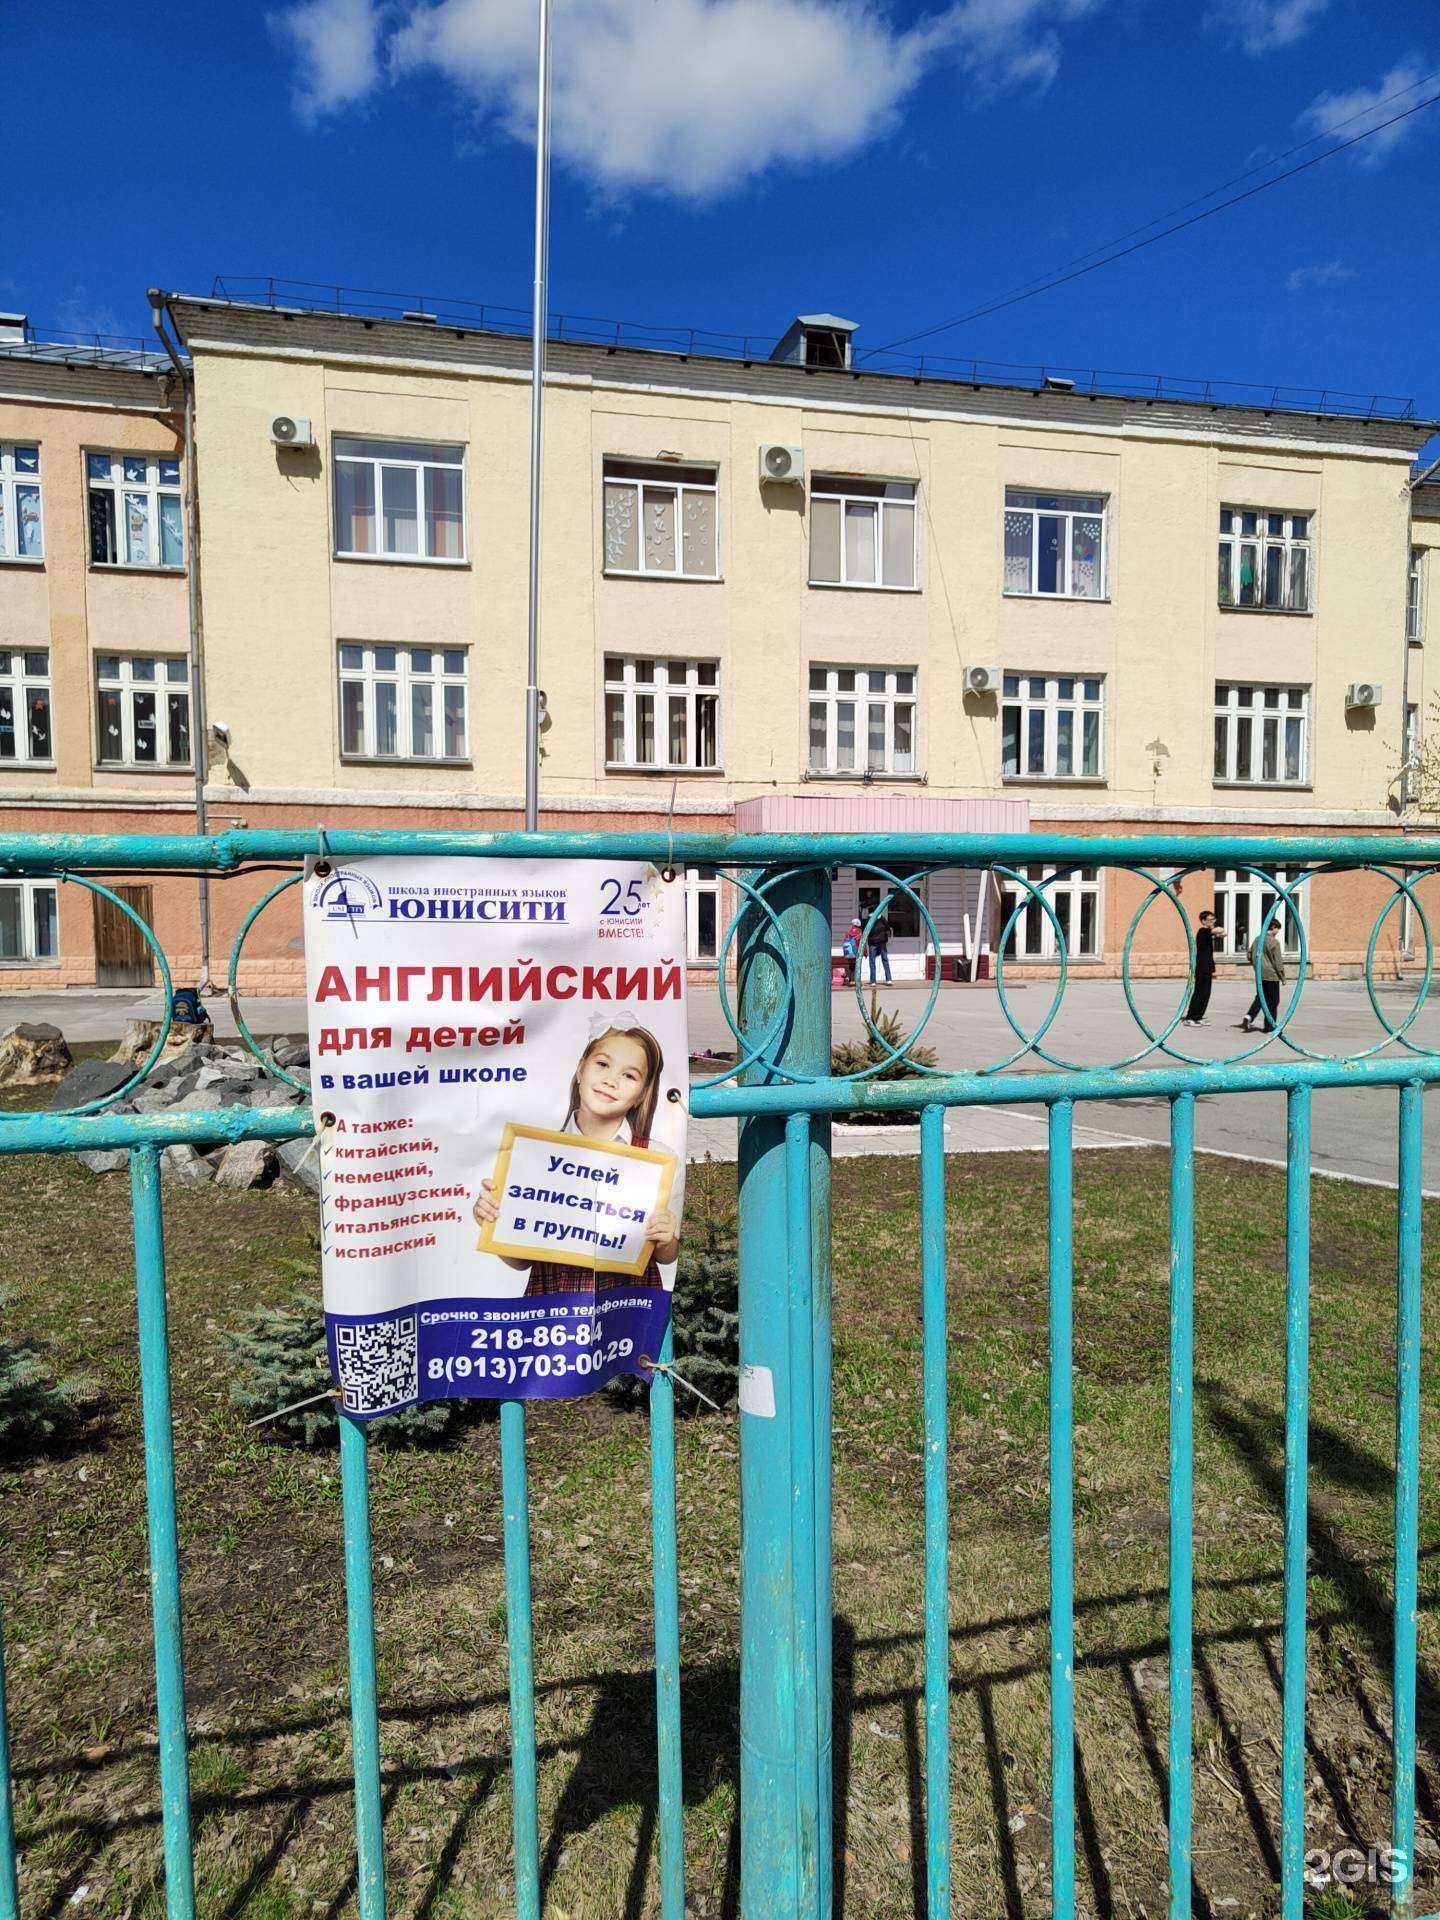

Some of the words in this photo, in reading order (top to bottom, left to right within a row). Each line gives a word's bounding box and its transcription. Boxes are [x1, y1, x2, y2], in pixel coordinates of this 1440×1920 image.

[388, 886, 430, 896] школа
[433, 887, 518, 899] иностранных
[521, 889, 567, 899] языков
[600, 878, 643, 916] 25
[388, 898, 567, 921] ЮНИСИТИ
[607, 917, 643, 926] ЮНИСИТИ
[598, 928, 645, 939] ВМЕСТЕ!
[315, 957, 682, 1002] АНГЛИЙСКИЙ
[318, 1026, 392, 1056] для
[405, 1018, 526, 1053] детей
[321, 1074, 335, 1090] в
[342, 1064, 430, 1090] вашей
[439, 1066, 528, 1084] школе
[336, 1118, 347, 1133] А
[352, 1117, 414, 1134] также:
[335, 1137, 440, 1159] китайский,
[334, 1161, 434, 1184] немецкий,
[548, 1155, 621, 1186] Успей
[334, 1184, 471, 1212] французский,
[508, 1184, 646, 1224] записаться
[334, 1208, 463, 1234] итальянский,
[513, 1217, 526, 1231] в
[533, 1219, 627, 1250] группы!
[335, 1233, 436, 1259] испанский
[420, 1311, 479, 1325] Срочно
[483, 1309, 546, 1322] звоните
[550, 1306, 569, 1317] по
[572, 1298, 653, 1317] телефонам:
[471, 1321, 603, 1351] 218-86-84
[427, 1338, 634, 1384] 8(913)703-00-29
